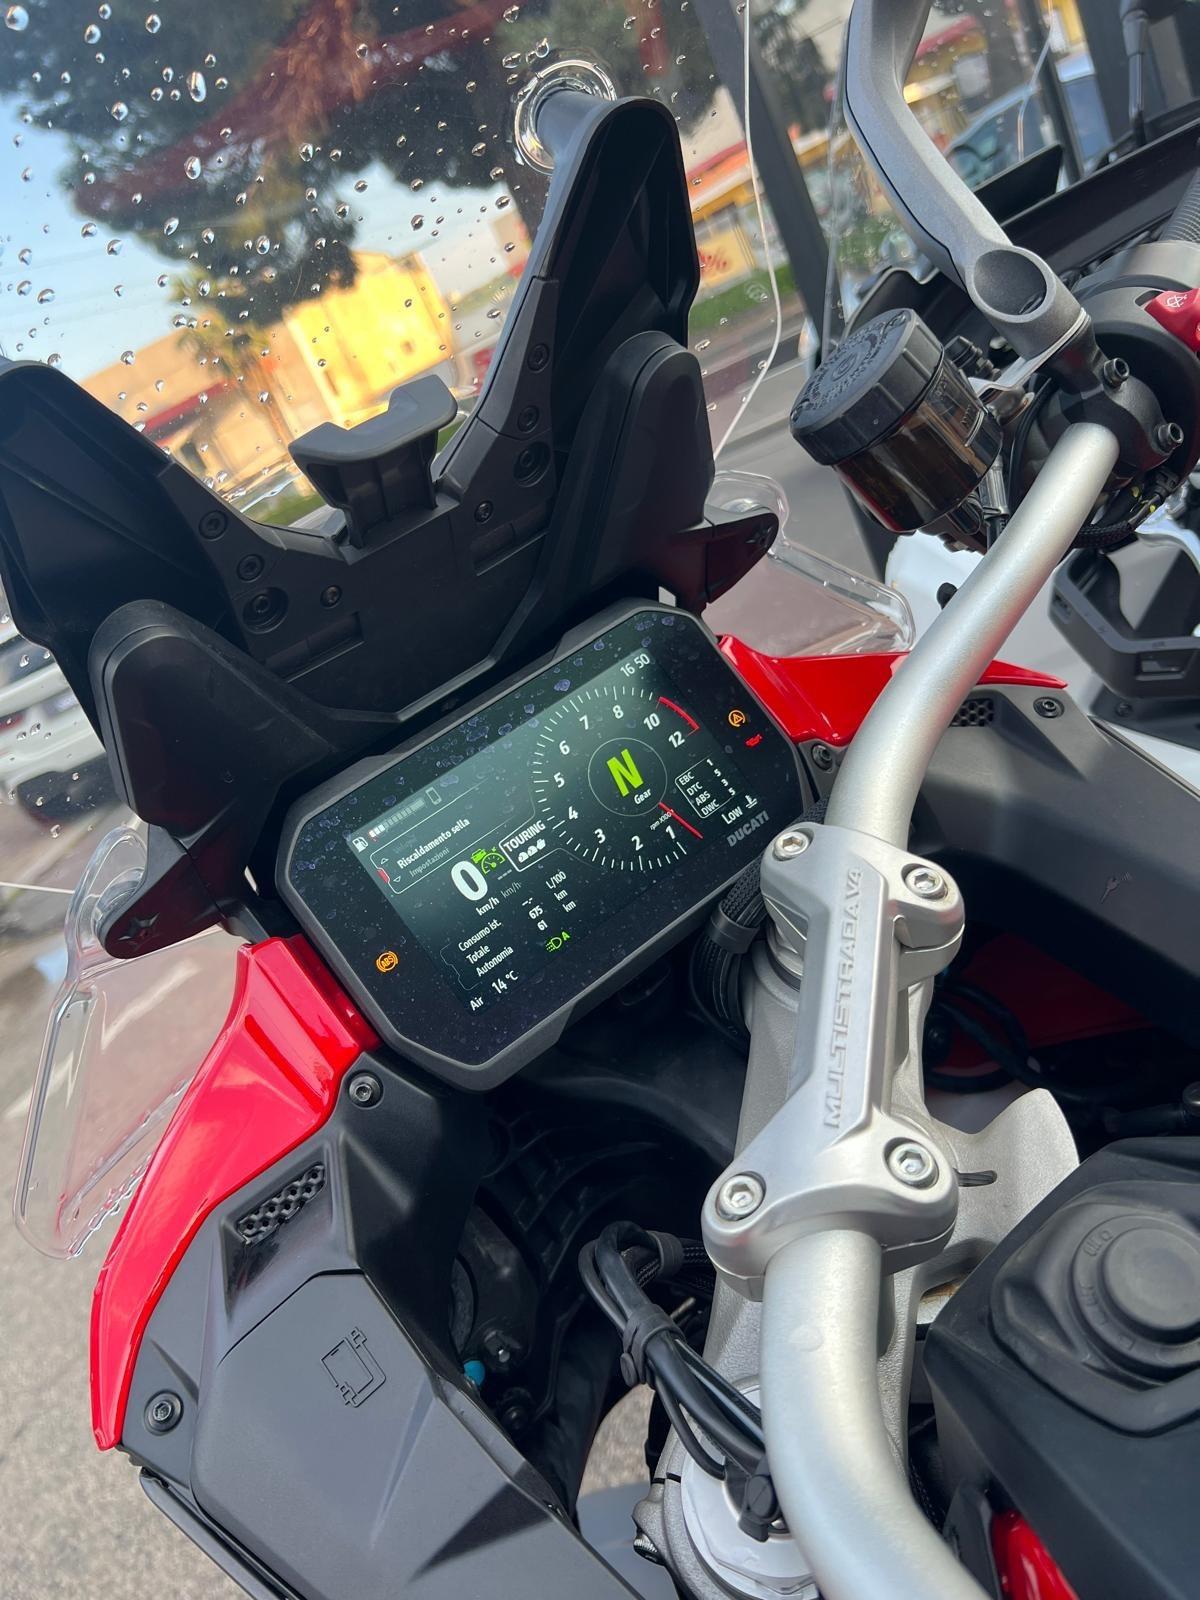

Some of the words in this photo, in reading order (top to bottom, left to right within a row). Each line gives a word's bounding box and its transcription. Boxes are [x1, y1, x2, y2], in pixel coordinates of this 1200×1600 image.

[620, 663, 635, 678] 16
[634, 653, 650, 668] 50
[612, 704, 624, 719] 8
[579, 714, 590, 730] 7
[643, 712, 660, 730] 10
[559, 740, 570, 756] 6
[668, 731, 685, 748] 12
[554, 772, 565, 788] 5
[607, 748, 644, 796] N
[678, 772, 694, 786] EBC
[634, 788, 652, 805] Gear
[686, 782, 702, 796] DTC
[696, 792, 711, 806] ABS
[568, 806, 578, 820] 4
[701, 800, 720, 816] DWC
[504, 820, 546, 852] TOURING
[594, 828, 606, 843] 3
[666, 825, 676, 840] 1
[727, 810, 770, 847] DUCATI
[397, 831, 451, 869] Riscaldamento
[451, 817, 470, 834] sella
[632, 836, 643, 850] 2
[409, 848, 450, 877] Impostazioni
[451, 860, 488, 900] 0
[501, 881, 522, 898] km/h
[458, 925, 490, 952] Consumo
[546, 871, 566, 889] L/100
[476, 896, 500, 916] km/h
[466, 944, 490, 965] Totale
[529, 906, 544, 920] 675
[554, 889, 568, 902] km
[476, 945, 514, 977] Autonomia
[538, 920, 548, 931] 61
[563, 900, 576, 913] km
[380, 956, 394, 967] ABS
[470, 996, 484, 1011] Air
[492, 978, 508, 994] 14
